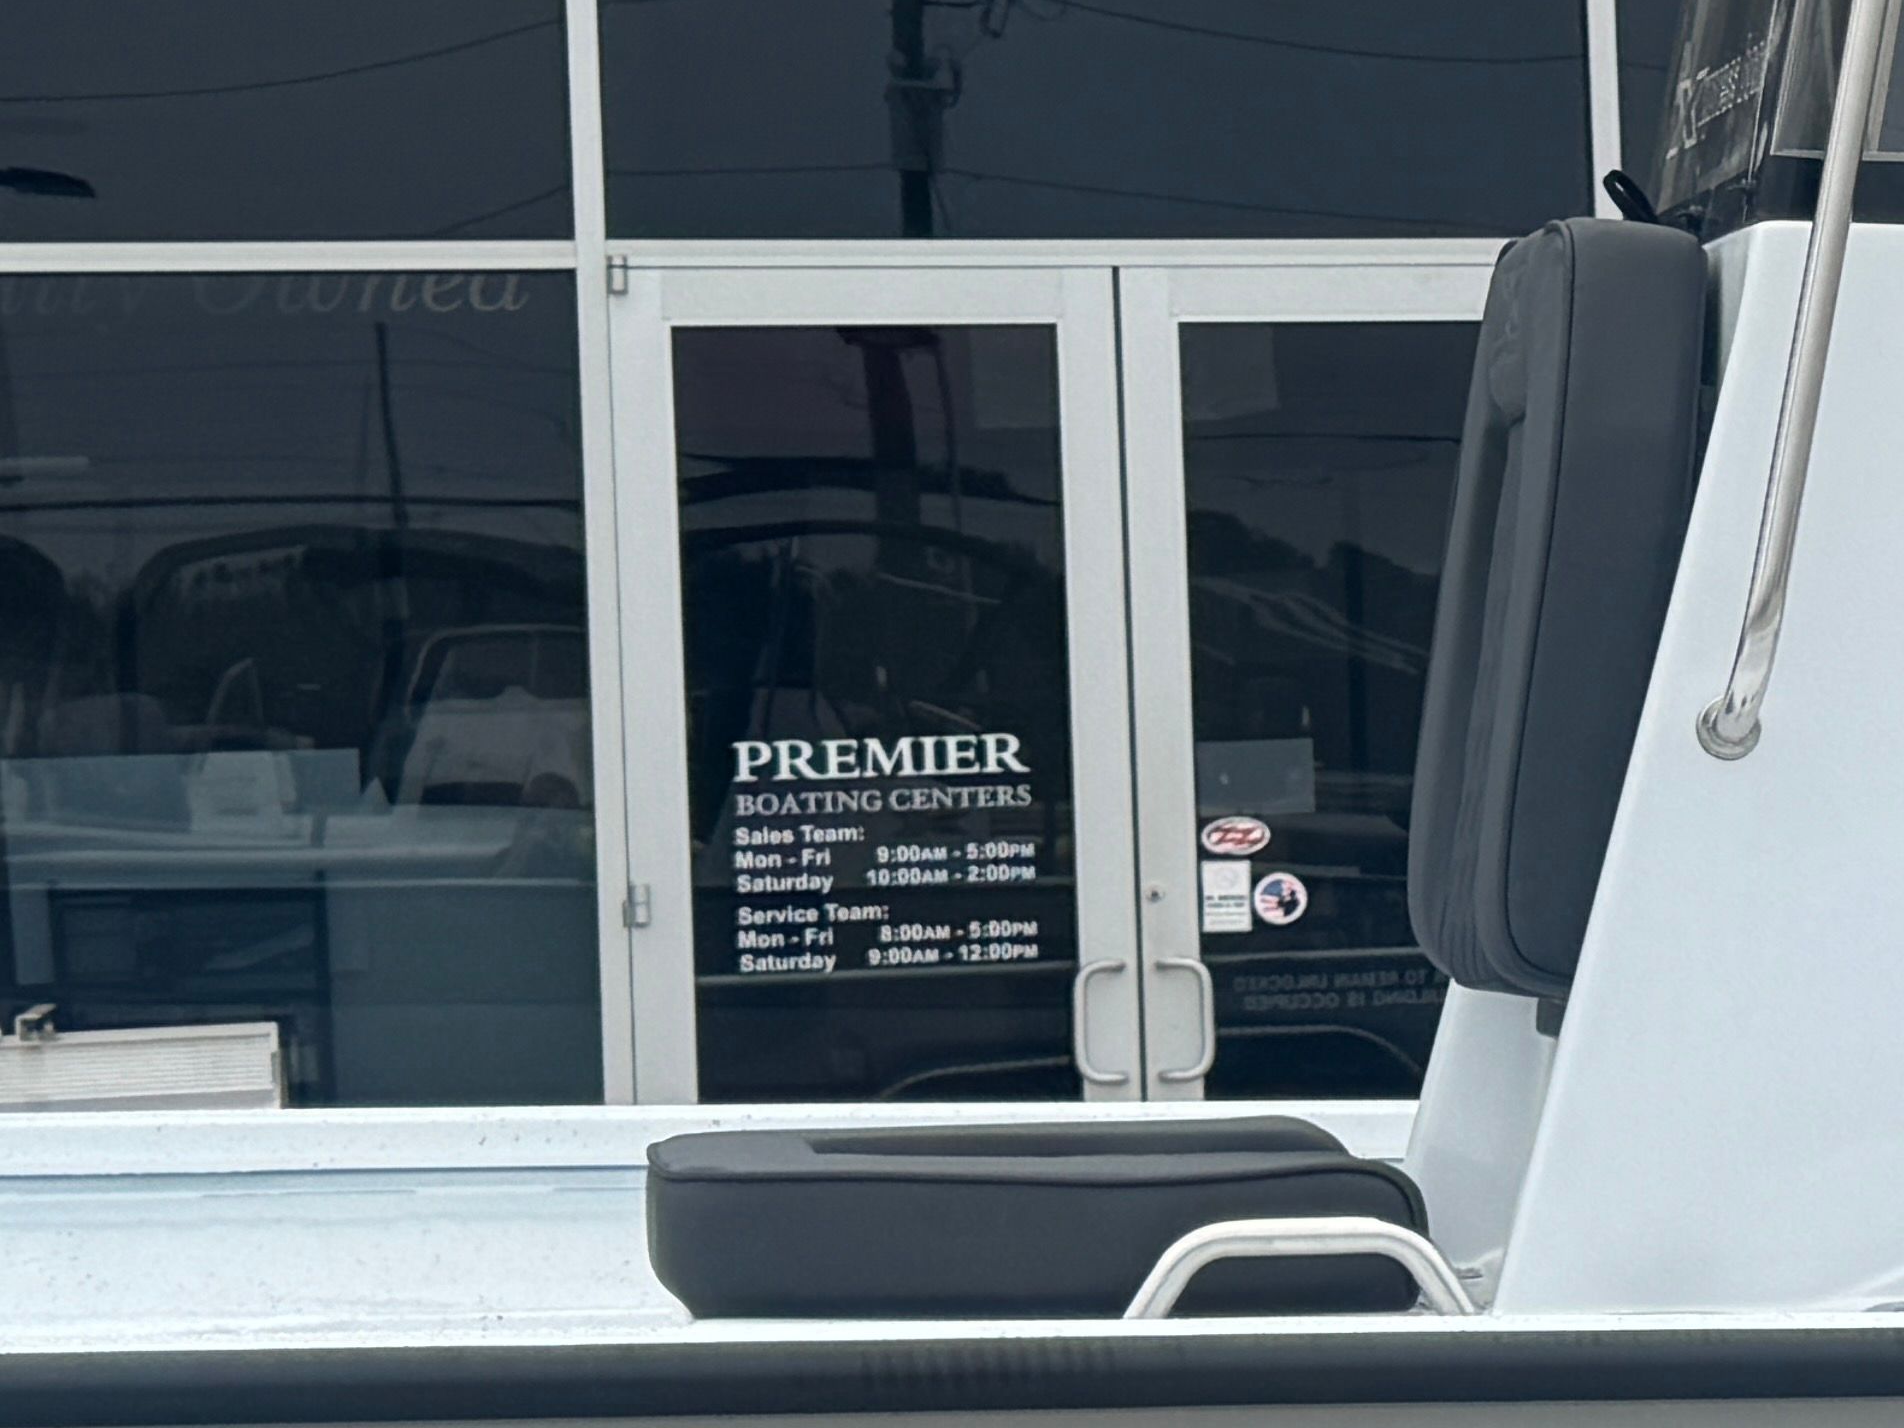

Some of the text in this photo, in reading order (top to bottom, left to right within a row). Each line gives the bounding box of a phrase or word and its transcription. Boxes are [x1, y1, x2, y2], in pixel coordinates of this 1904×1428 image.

[731, 732, 1032, 784] PREMIER
[735, 783, 1033, 818] BOATING CENTERS
[733, 822, 866, 846] Sales Team:
[735, 850, 782, 870] Mon
[801, 847, 832, 867] Fri
[876, 844, 948, 864] 9:00AM
[966, 840, 1036, 860] 5:00PM
[736, 873, 834, 895] Saturday
[866, 866, 949, 888] 10:00AM
[966, 863, 1036, 883] 2:00PM
[737, 902, 890, 926] Service Team:
[737, 930, 785, 950] Mon
[804, 927, 834, 947] Fri
[968, 920, 1038, 940] 5:00PM
[739, 952, 837, 974] Saturday
[867, 946, 940, 967] 9:00AM
[957, 943, 1038, 963] 12:00PM
